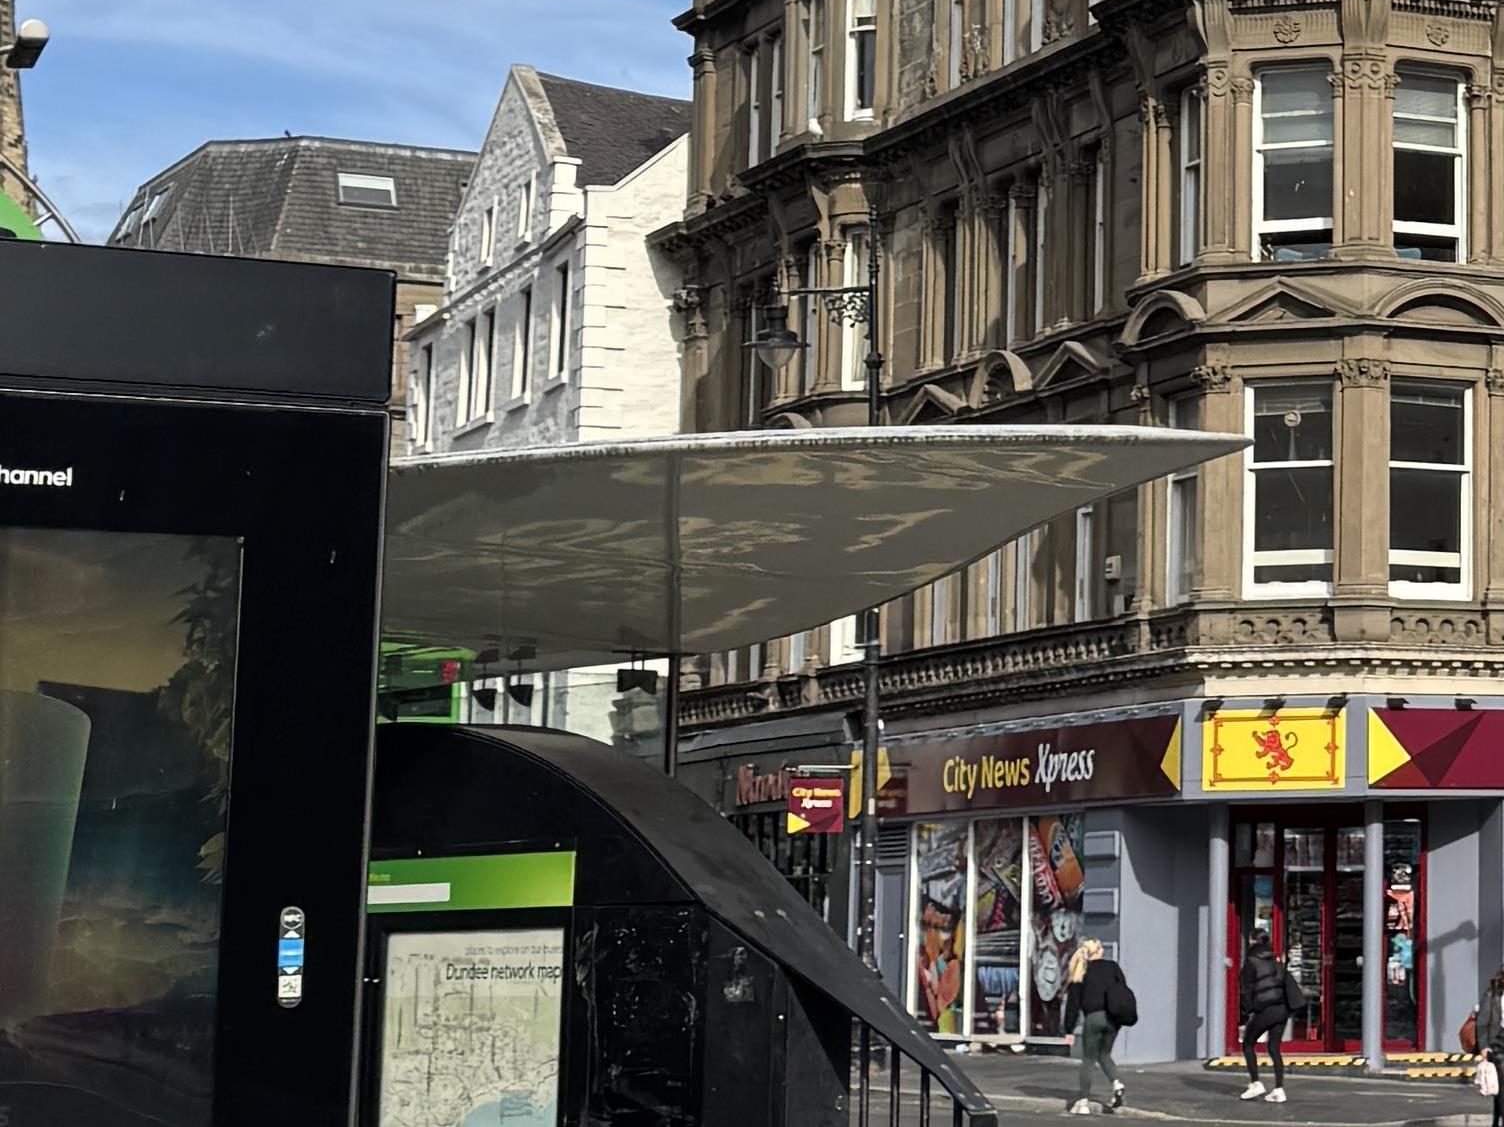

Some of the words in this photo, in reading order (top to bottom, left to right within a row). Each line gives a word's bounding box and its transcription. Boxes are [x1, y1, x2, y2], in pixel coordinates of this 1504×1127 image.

[943, 755, 978, 800] City
[981, 755, 1030, 789] News
[1034, 743, 1095, 793] Xpress
[447, 962, 488, 981] Dundee
[491, 961, 533, 980] network
[537, 966, 561, 984] map
